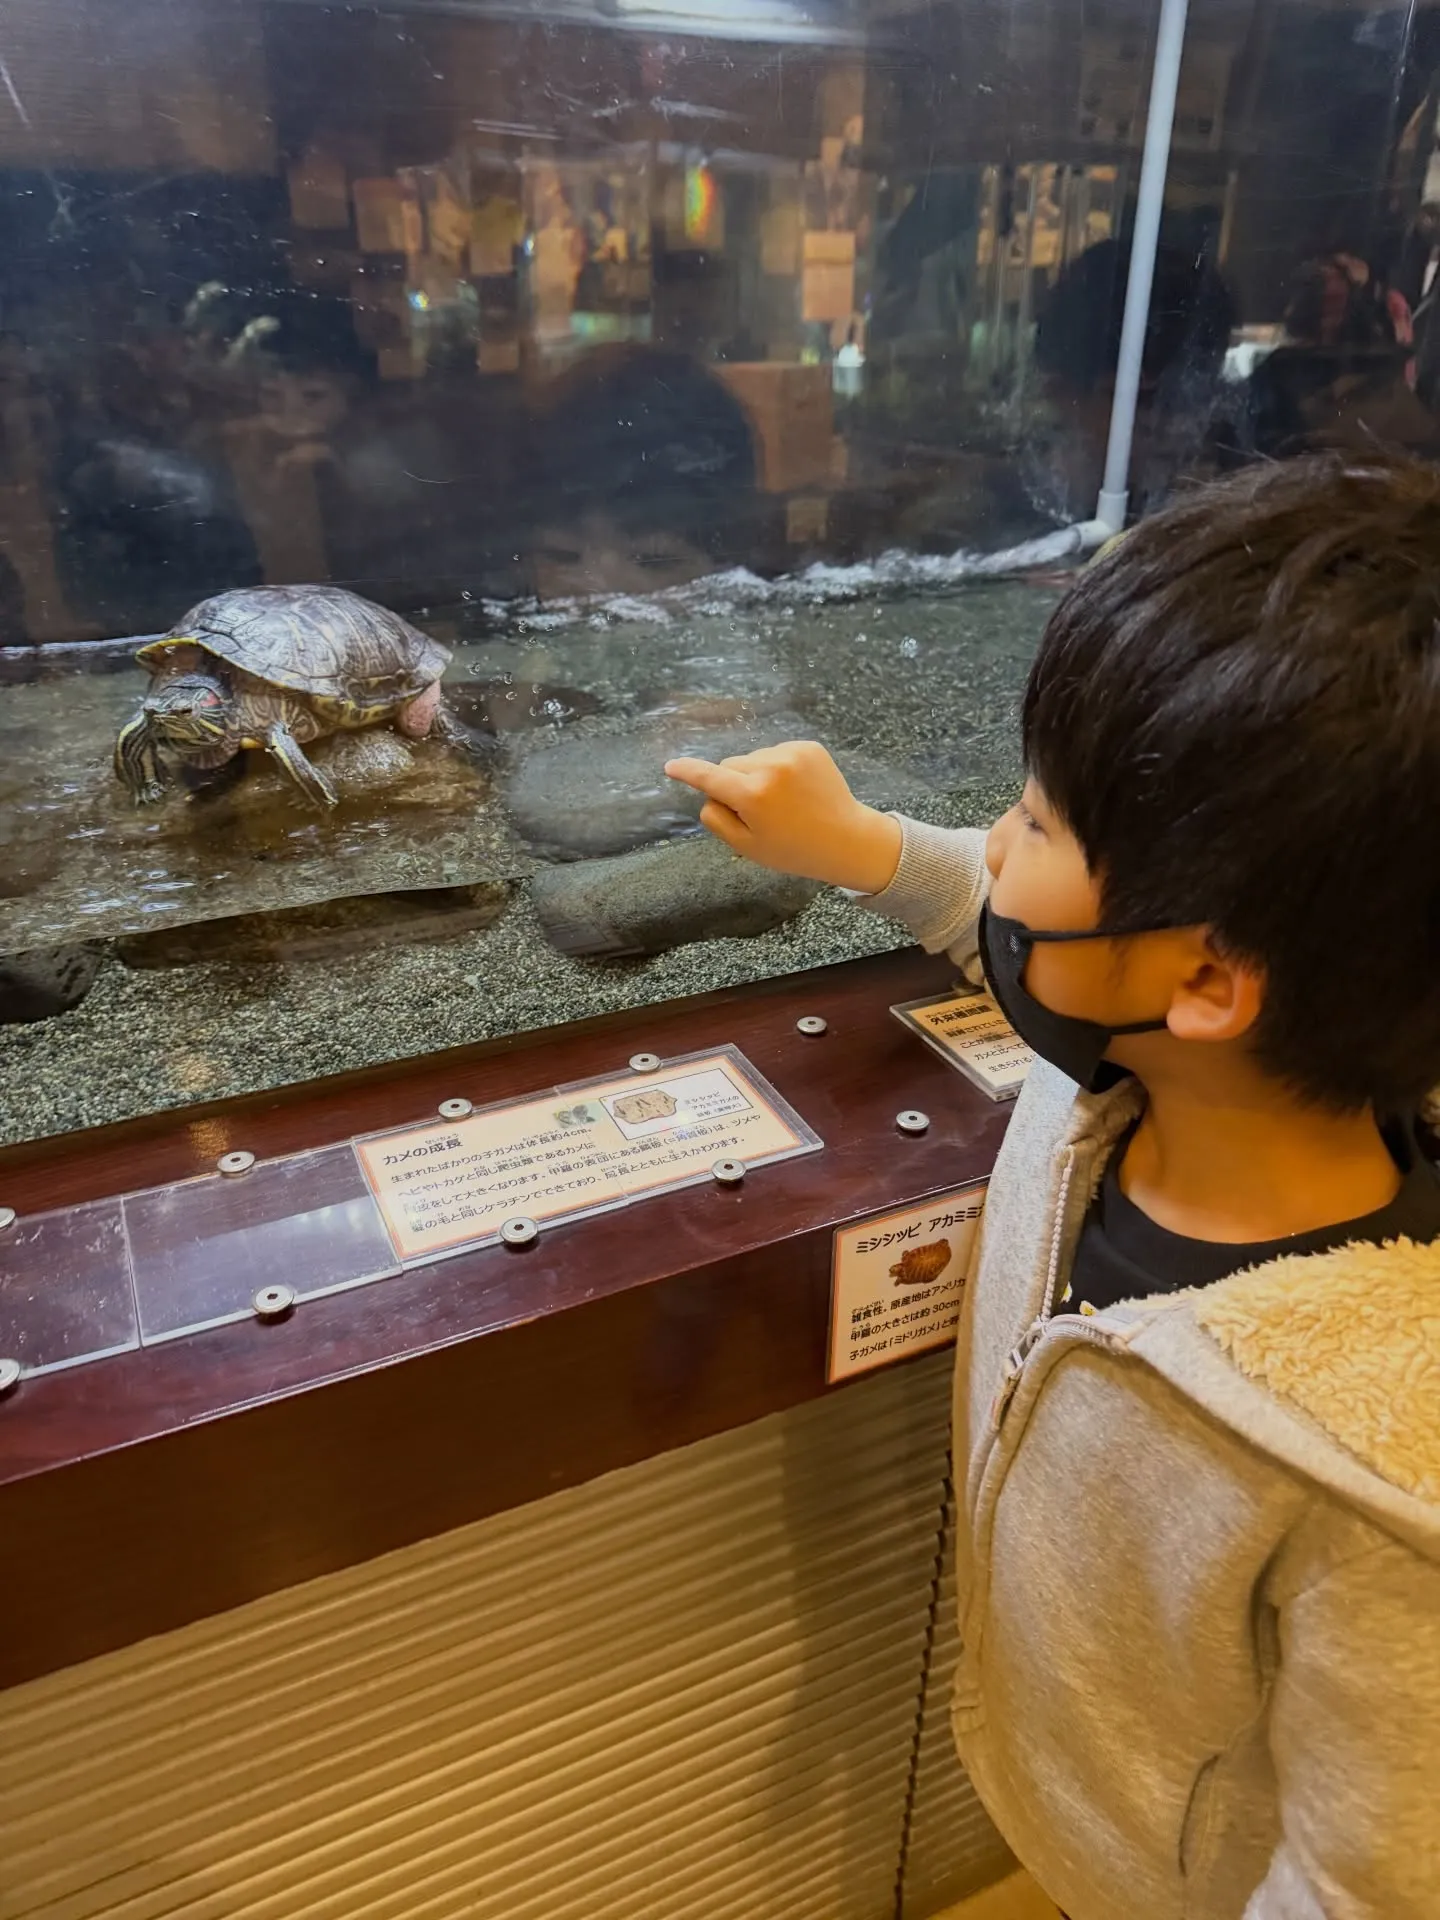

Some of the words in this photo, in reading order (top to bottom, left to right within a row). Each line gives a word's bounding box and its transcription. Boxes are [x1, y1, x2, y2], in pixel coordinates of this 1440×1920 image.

[383, 1138, 463, 1166] カメの成長
[856, 1222, 922, 1253] ミシシッピ
